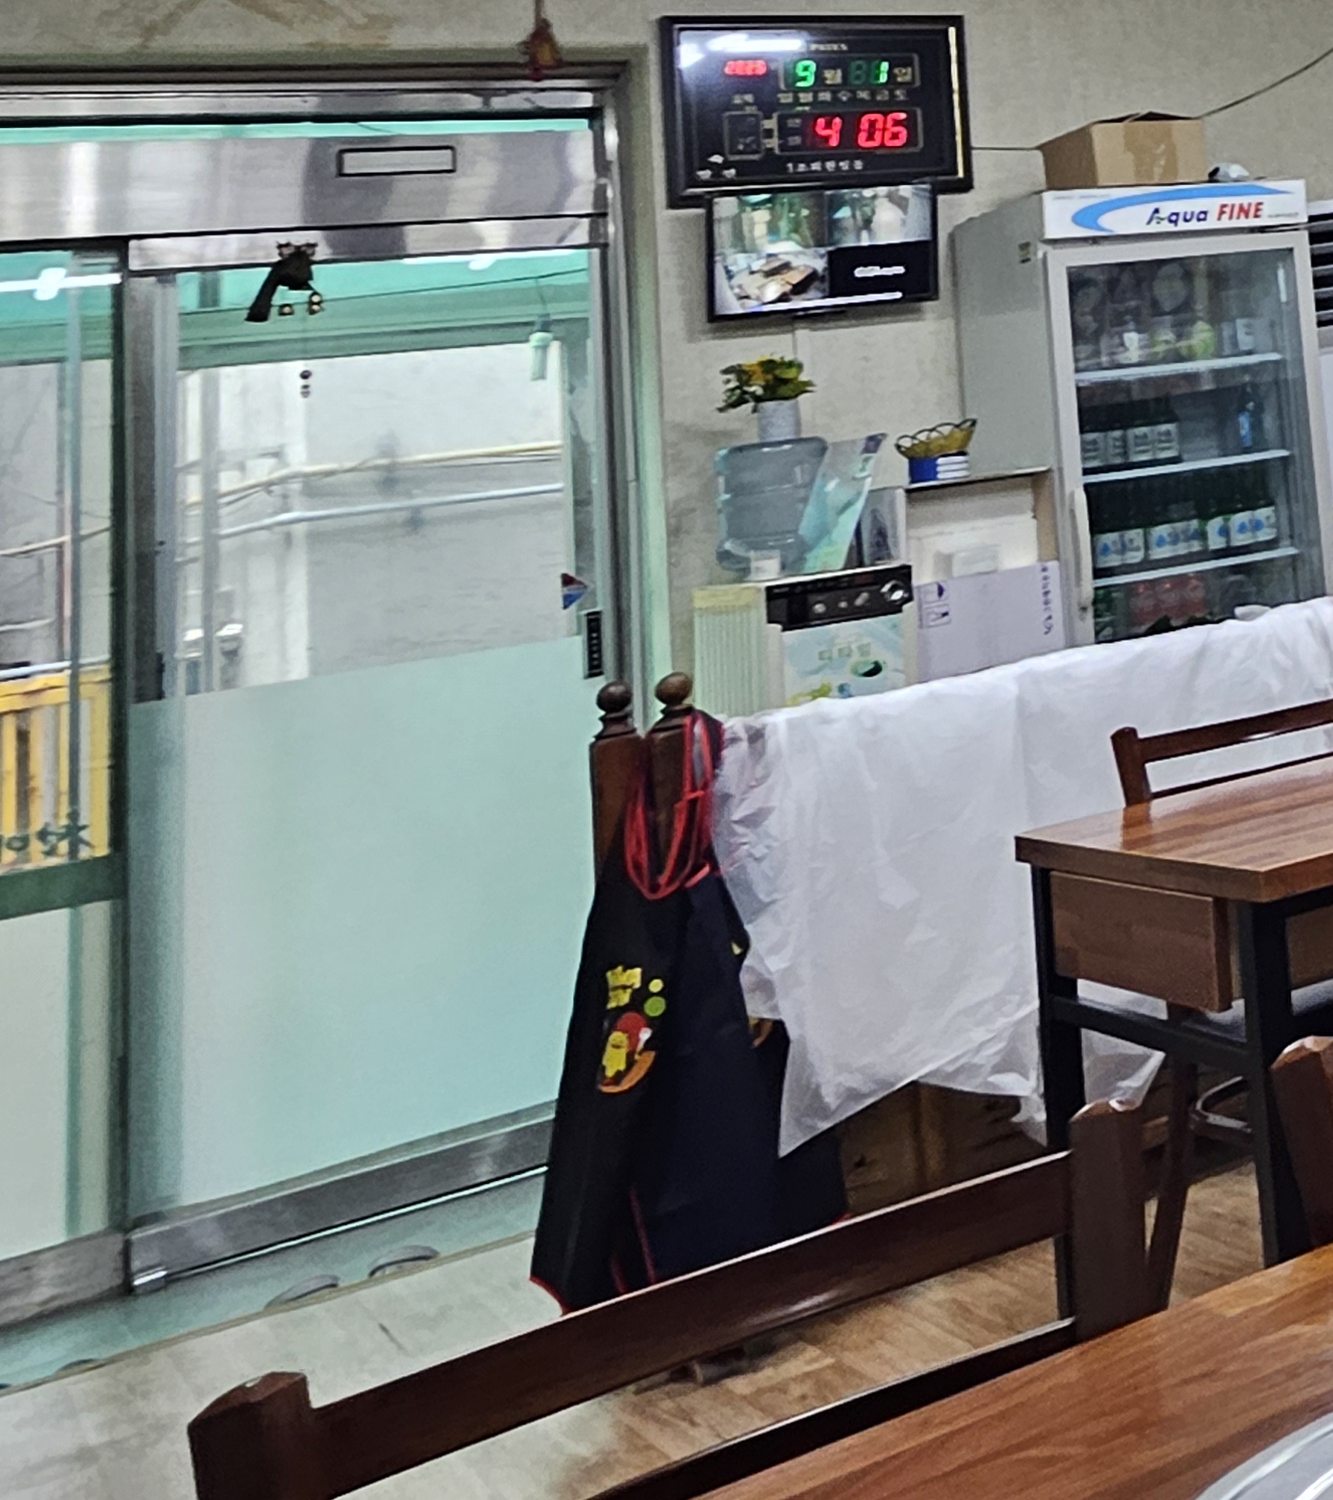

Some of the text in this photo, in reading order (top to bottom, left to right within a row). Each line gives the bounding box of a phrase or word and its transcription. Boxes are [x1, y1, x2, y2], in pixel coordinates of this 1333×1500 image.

[795, 60, 816, 88] 9
[1146, 207, 1210, 227] Aqua
[1217, 202, 1265, 221] FINE
